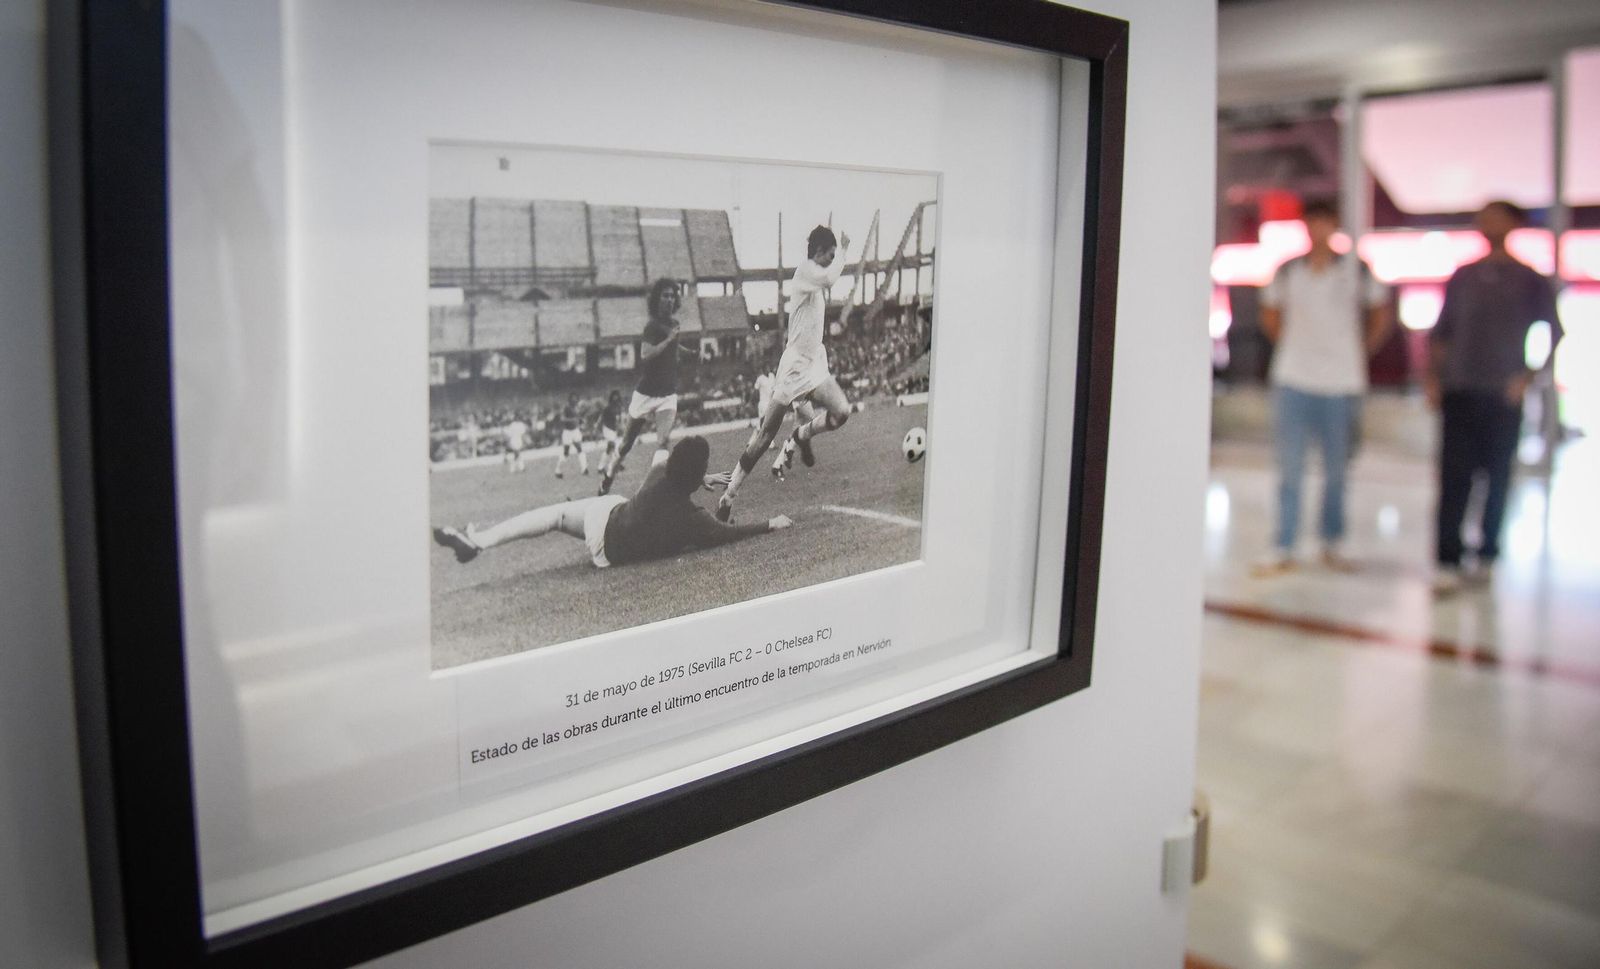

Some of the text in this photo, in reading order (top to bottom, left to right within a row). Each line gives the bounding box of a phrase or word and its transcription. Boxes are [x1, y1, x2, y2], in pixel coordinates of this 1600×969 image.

[471, 638, 892, 764] Estado de las obras durante el último encuentro de la temporada en Nervión
[565, 693, 580, 708] 31
[583, 690, 600, 703] de
[603, 680, 637, 698] mayo
[640, 674, 656, 687] de
[658, 666, 685, 684] 1975
[688, 657, 726, 677] (Sevilla
[729, 650, 743, 664] FC
[745, 648, 753, 660] 2
[765, 643, 773, 655] 0
[774, 635, 814, 653] Chelsea
[816, 627, 833, 641] FC)
